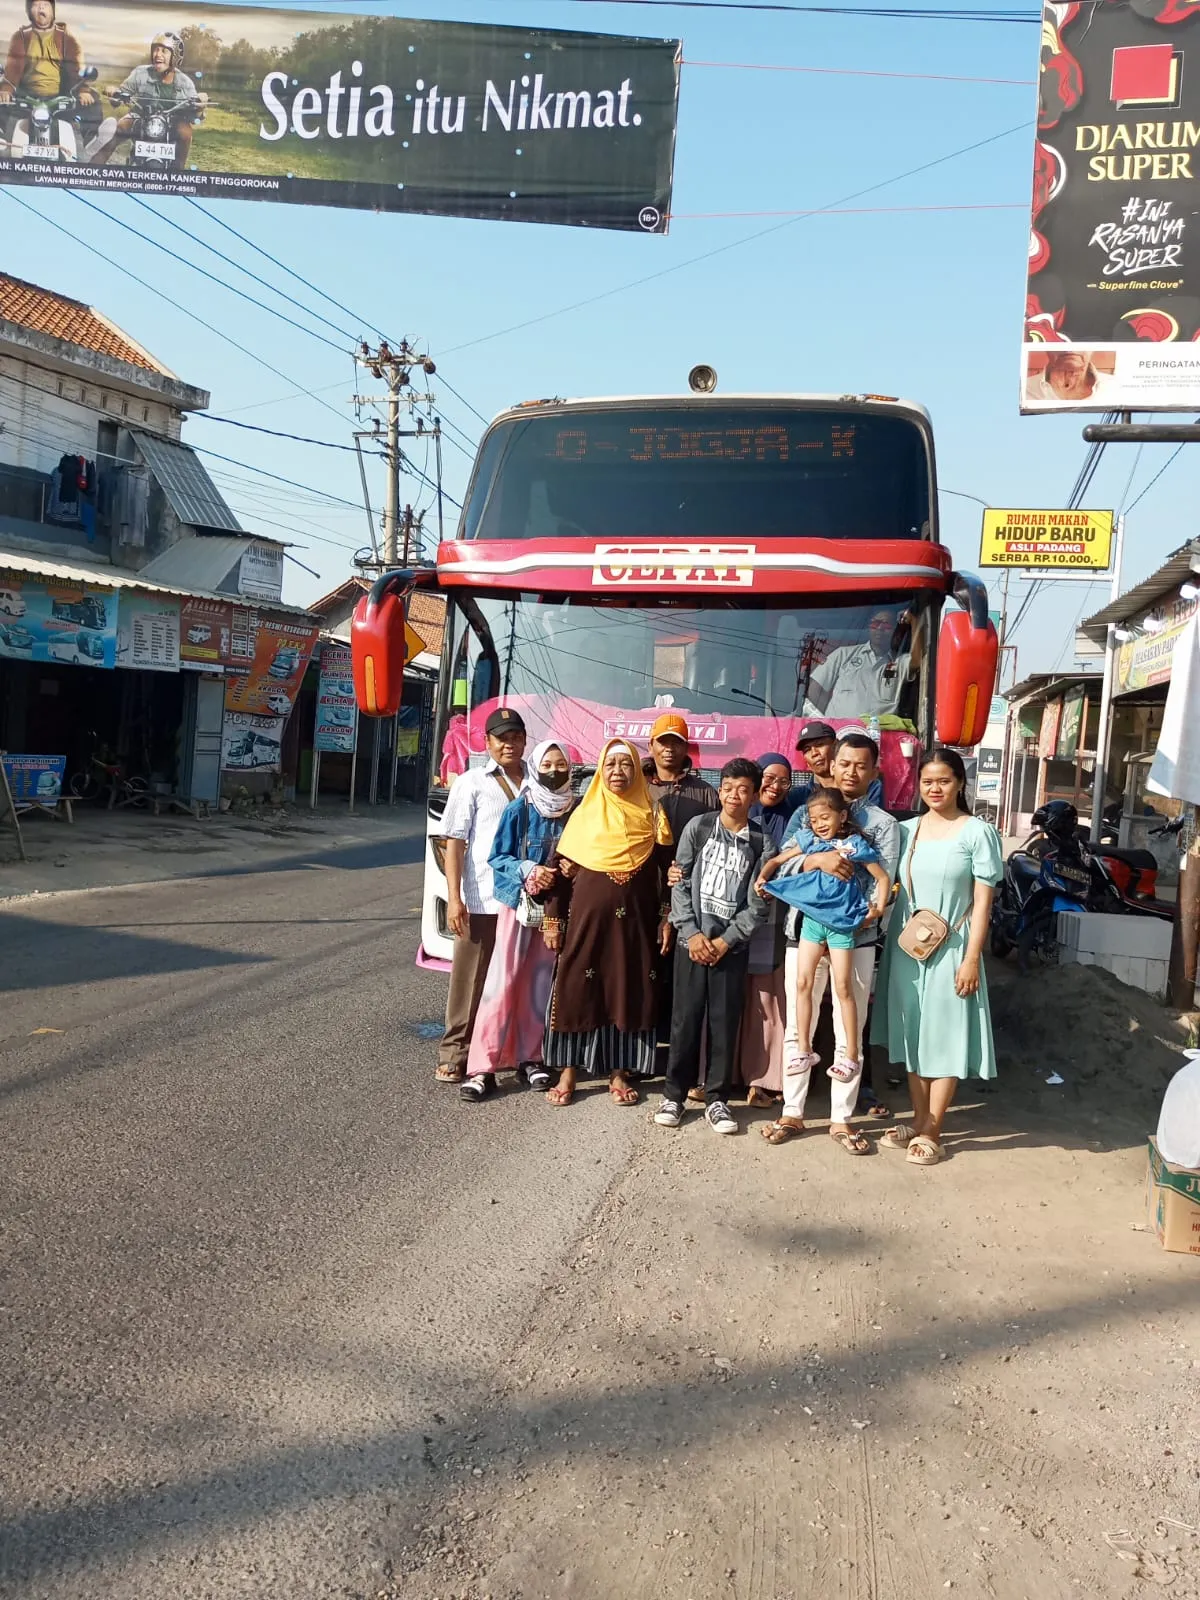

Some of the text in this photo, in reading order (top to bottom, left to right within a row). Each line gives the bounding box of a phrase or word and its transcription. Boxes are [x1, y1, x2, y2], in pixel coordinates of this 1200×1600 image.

[260, 61, 643, 141] Setia itu Nikmat.
[1075, 121, 1200, 154] DJARUM
[1087, 153, 1194, 181] SUPER
[14, 163, 52, 174] KARENA
[102, 170, 125, 180] SAYA
[127, 171, 168, 182] TERKENA
[170, 174, 208, 185] KANKER
[209, 177, 279, 190] TENGGOROKAN
[35, 175, 68, 184] LAYANAN
[69, 178, 106, 188] BERHENTI
[107, 181, 143, 190] MEROKOK
[642, 214, 657, 223] 18+
[1088, 218, 1186, 253] RASANYA
[1102, 242, 1184, 276] SUPER
[1098, 281, 1149, 292] Superfine
[1006, 514, 1089, 526] RUMAH MAKAN
[995, 526, 1096, 542] HIDUP BARU
[1009, 543, 1081, 553] ASLI PADANG
[991, 553, 1030, 563] SERBA
[614, 723, 716, 739] SURYA
